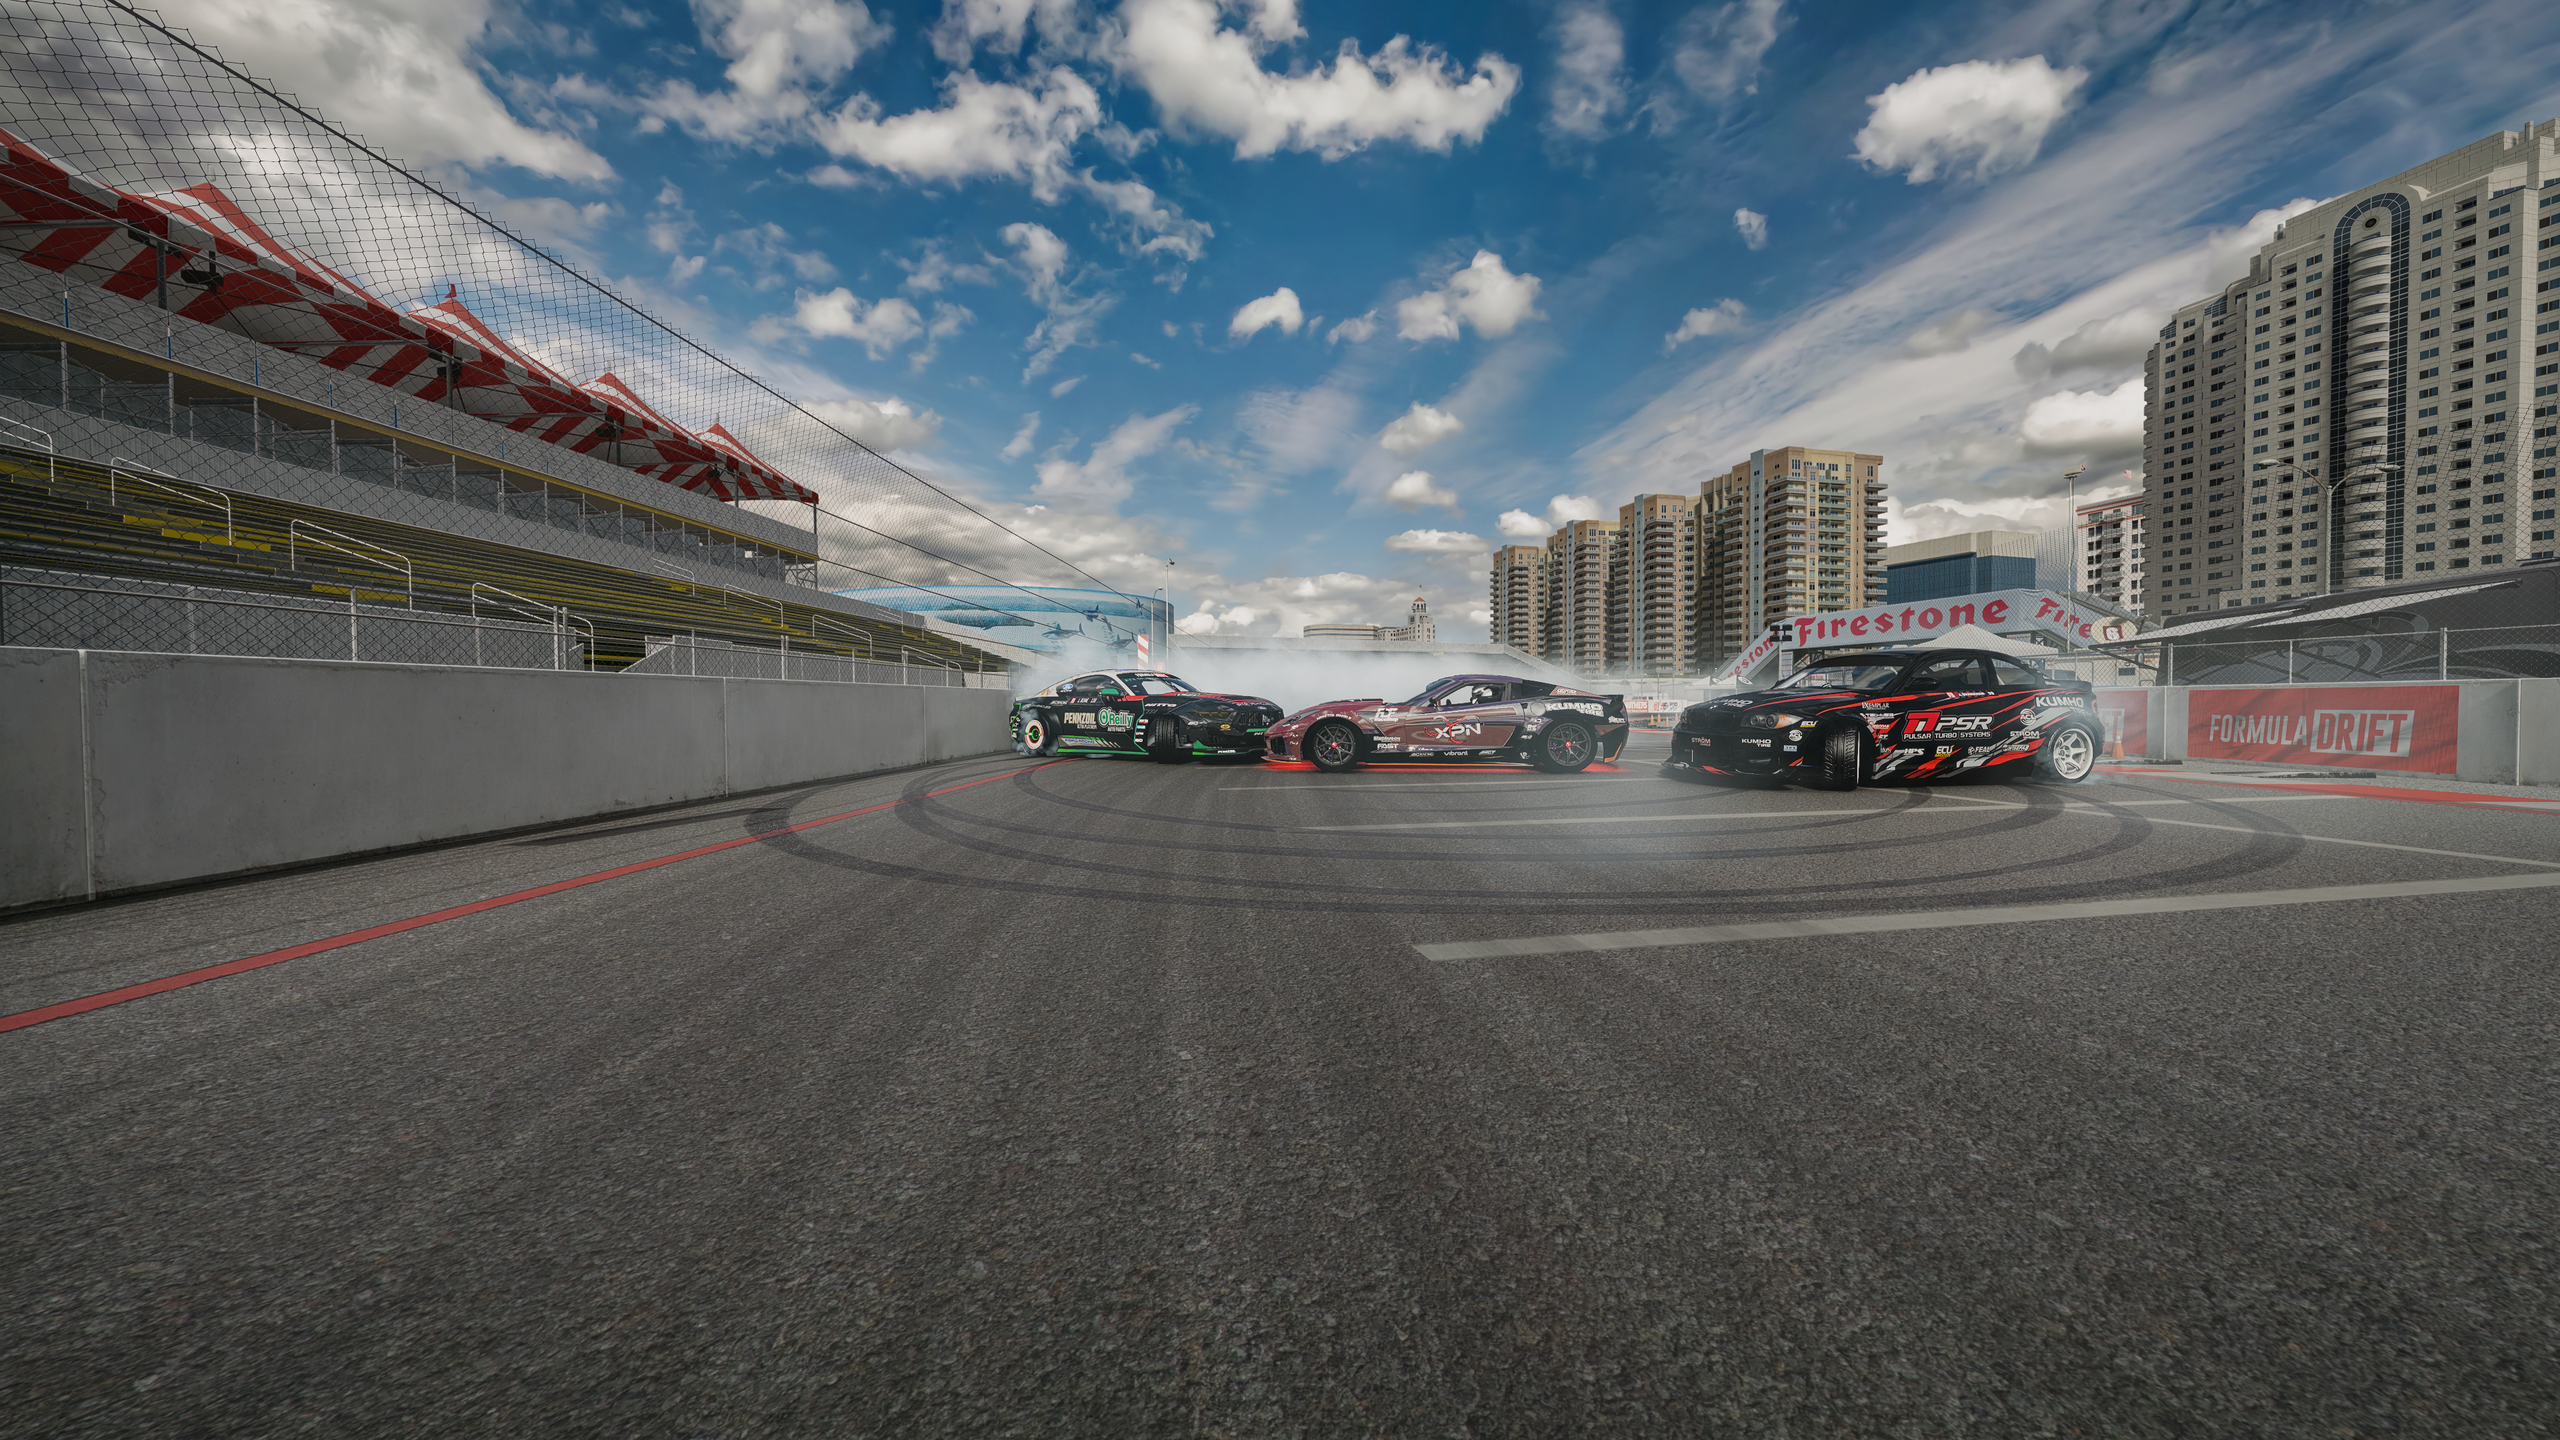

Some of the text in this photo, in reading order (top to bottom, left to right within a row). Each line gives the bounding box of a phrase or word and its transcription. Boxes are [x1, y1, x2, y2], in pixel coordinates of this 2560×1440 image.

[1794, 600, 2009, 647] Firestone
[1545, 702, 1604, 712] KUMHO
[2035, 696, 2084, 708] KUMHO
[1064, 712, 1096, 724] PENNZOIL
[1099, 709, 1133, 728] O'Reilly
[1935, 716, 1993, 731] PSR
[1434, 722, 1482, 740] XPN
[1904, 732, 1932, 740] PULSAR
[1935, 731, 1957, 739] TURBO
[2010, 729, 2039, 737] STRÖM
[2209, 712, 2408, 753] FORMULA DRIFT
[1936, 746, 1953, 754] ECU
